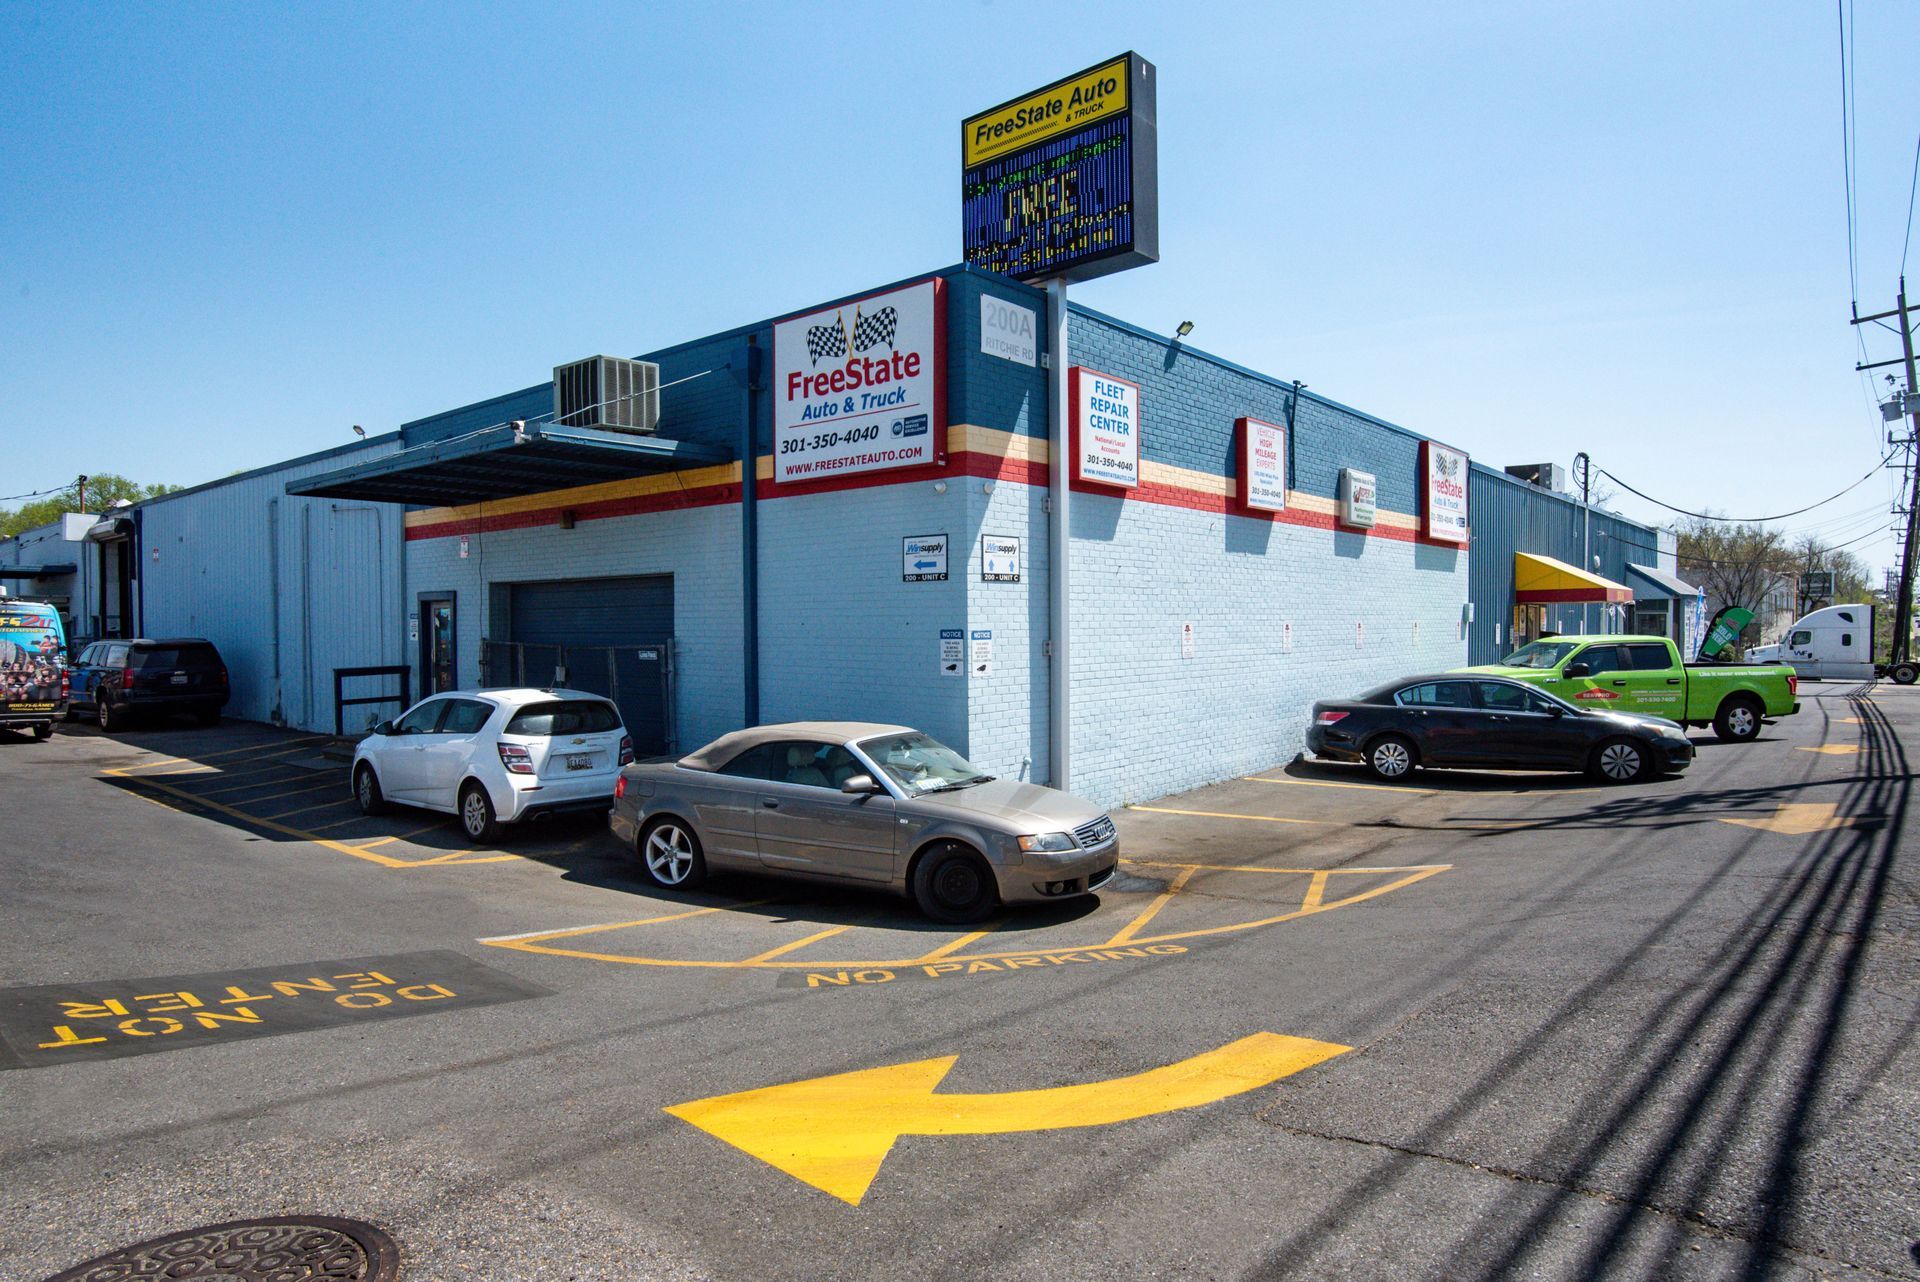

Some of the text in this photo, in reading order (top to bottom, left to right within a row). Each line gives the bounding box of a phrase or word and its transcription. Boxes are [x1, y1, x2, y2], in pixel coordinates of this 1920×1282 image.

[975, 77, 1118, 146] FreeState Auto
[1065, 101, 1104, 122] & TRUCK
[986, 302, 1033, 340] 200A
[985, 336, 1034, 361] RITCHIE RD
[788, 350, 920, 401] FreeState
[1095, 380, 1125, 401] FLEET
[801, 386, 906, 421] Auto & Truck
[1091, 397, 1129, 419] REPAIR
[1090, 414, 1130, 436] CENTER
[1257, 427, 1275, 439] VEHICLE
[781, 425, 879, 454] 301-350-4040
[1259, 440, 1272, 449] HIGH
[786, 447, 922, 476] WWW.FREESTATEAUTO.COM
[1087, 454, 1133, 471] 301-350-4040
[1255, 448, 1277, 460] MILEAGE
[1256, 459, 1275, 470] EXPERTS
[1251, 486, 1281, 498] 301-350-4040
[1432, 474, 1462, 498] FreeState
[907, 543, 944, 553] Winsupply
[986, 542, 1017, 554] Winsupply
[807, 943, 1189, 988] NO PARKING
[58, 970, 396, 1019] ENTER
[37, 983, 457, 1049] DO NOT
